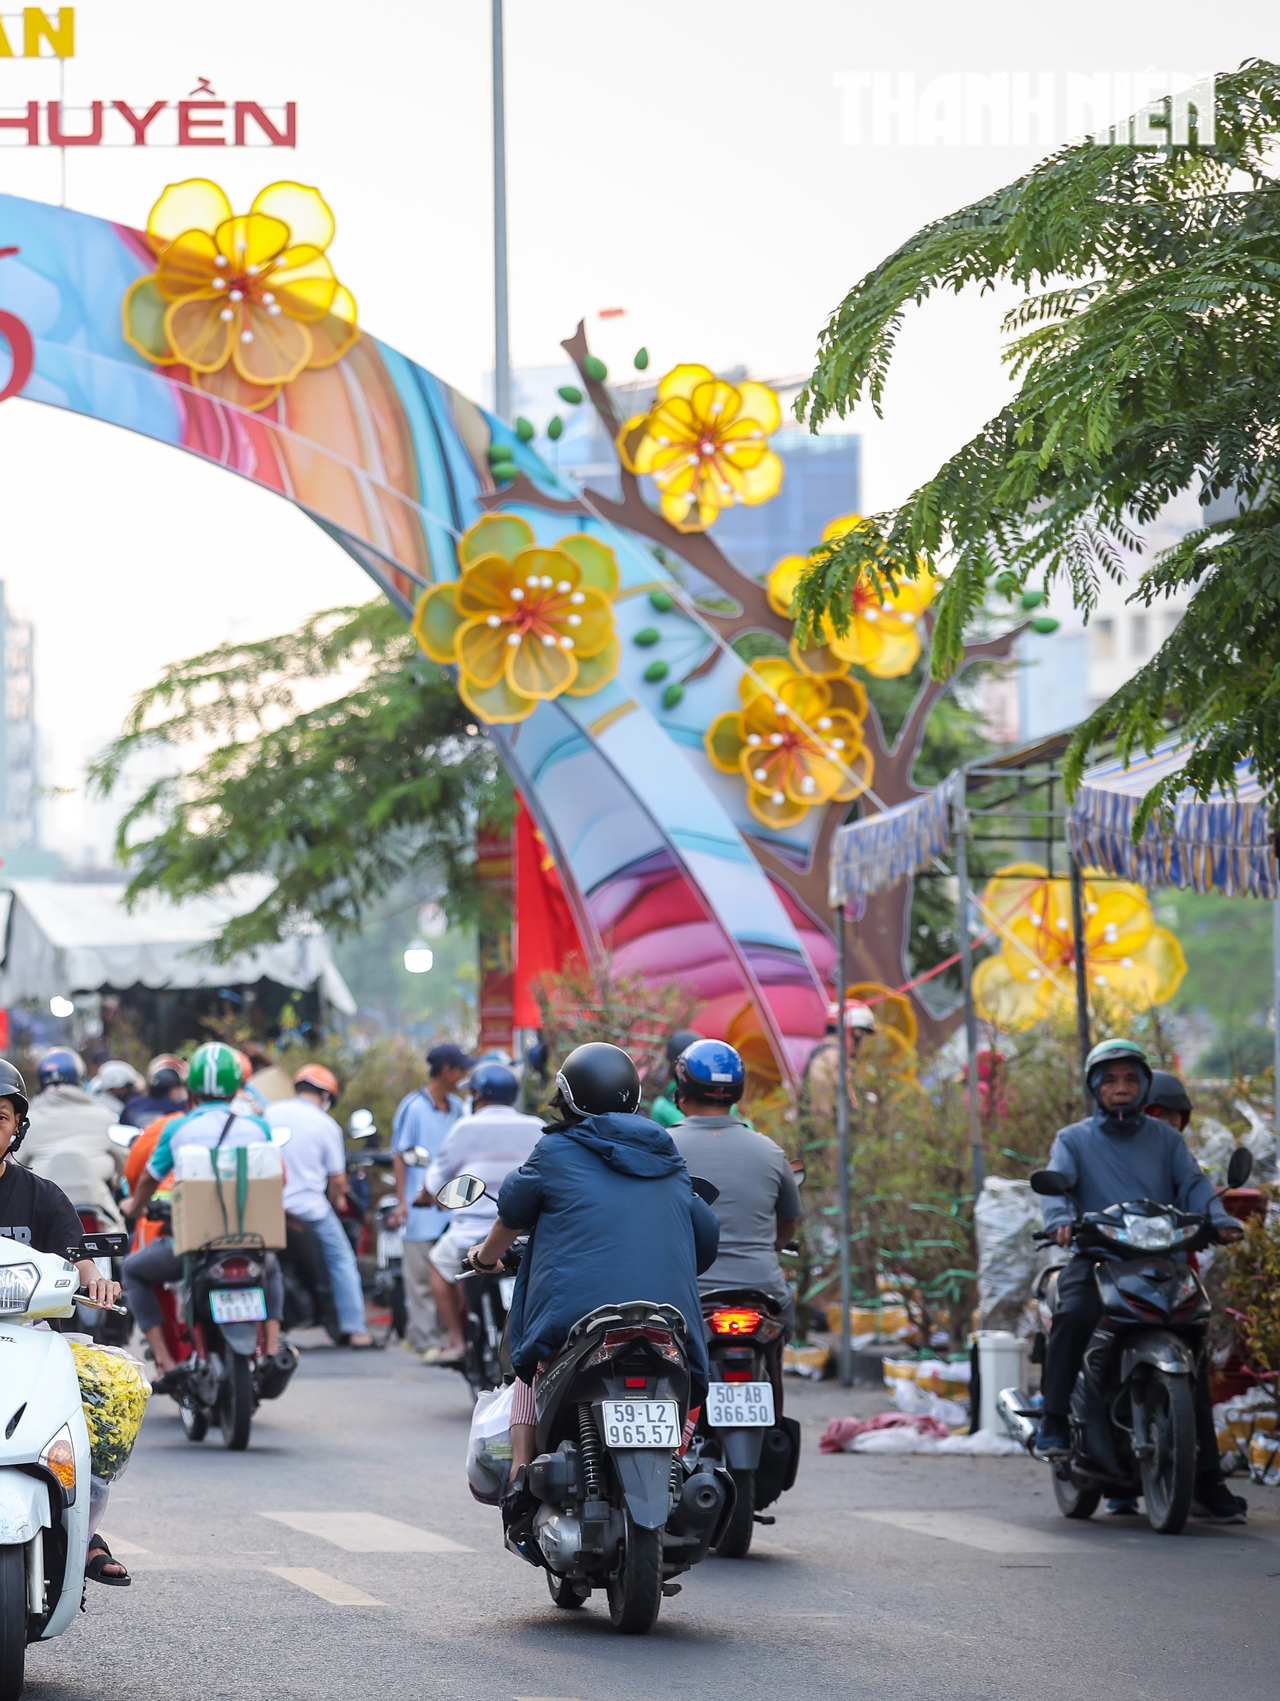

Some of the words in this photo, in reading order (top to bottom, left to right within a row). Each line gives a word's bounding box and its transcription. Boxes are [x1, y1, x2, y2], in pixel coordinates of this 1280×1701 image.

[716, 1387, 762, 1404] 50-AB
[613, 1404, 667, 1423] 59-L2
[713, 1405, 768, 1423] 366.50
[609, 1425, 674, 1444] 965.57
